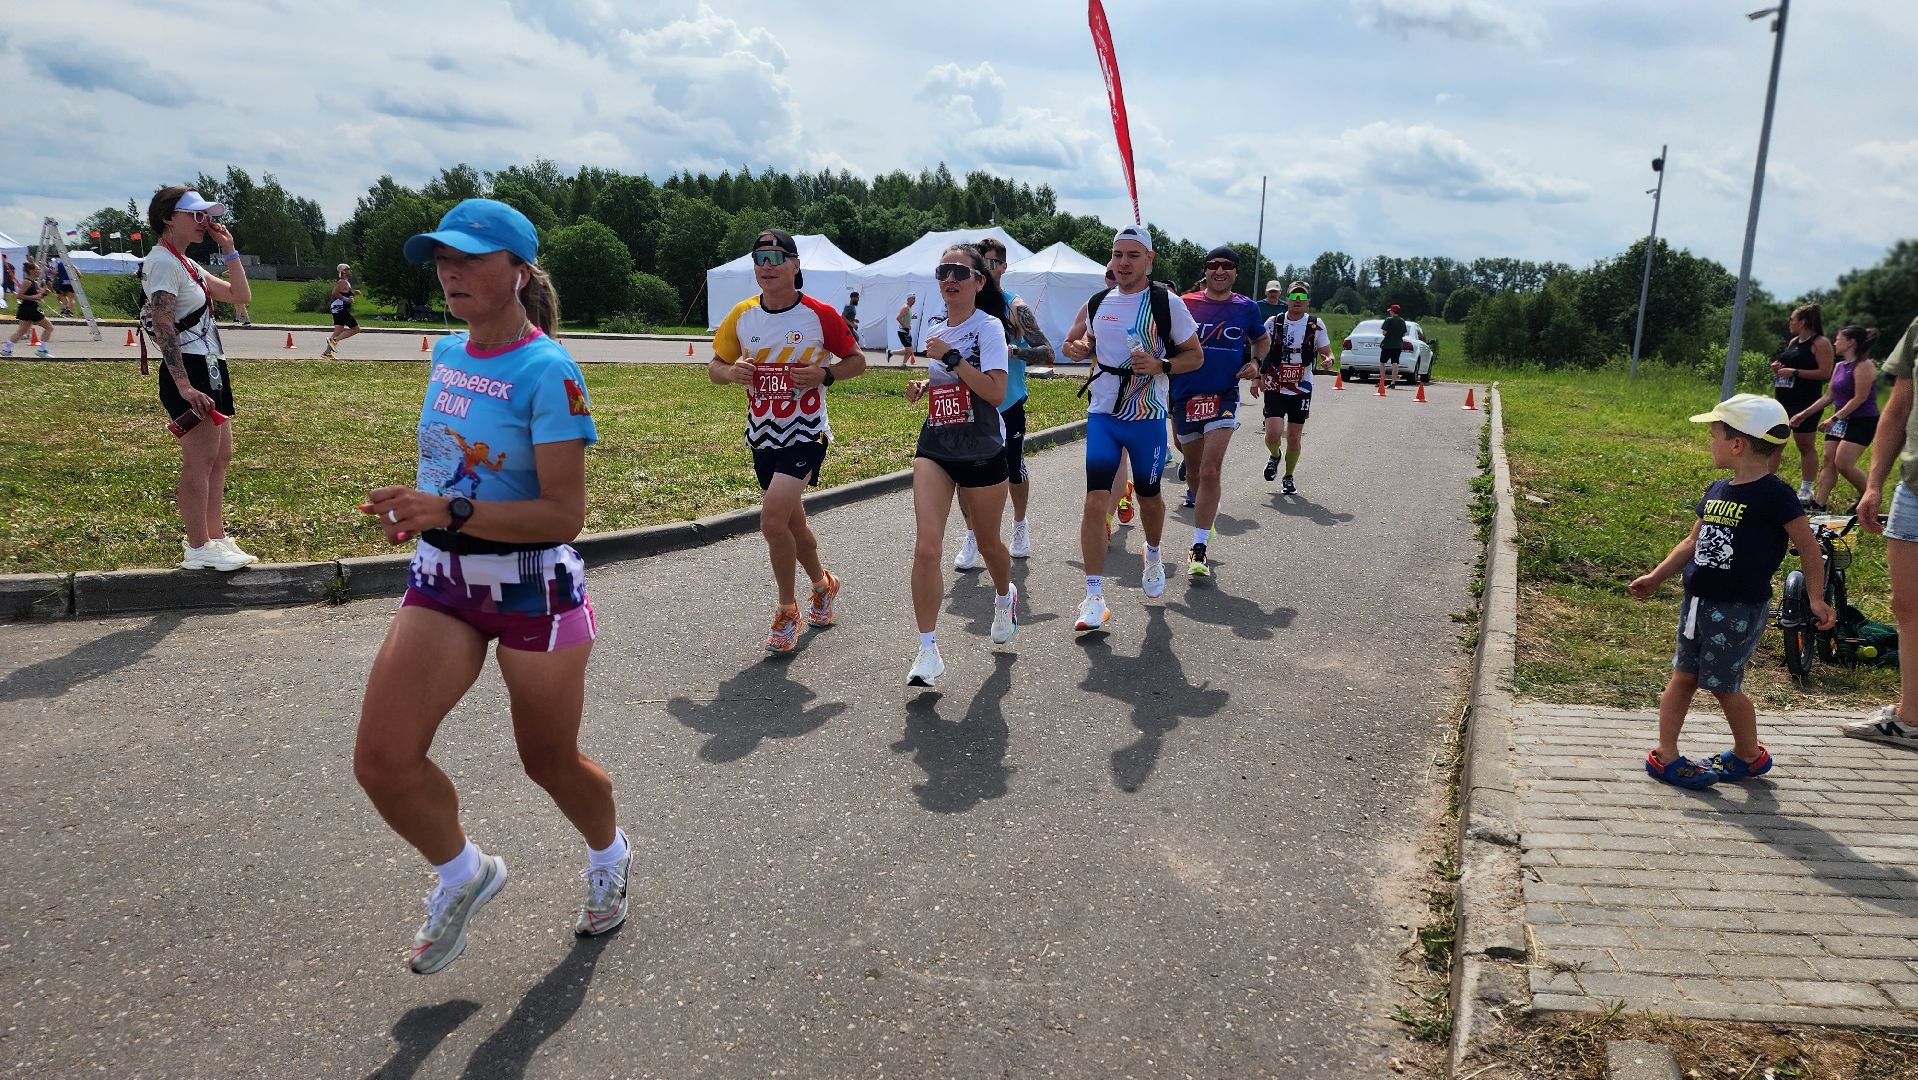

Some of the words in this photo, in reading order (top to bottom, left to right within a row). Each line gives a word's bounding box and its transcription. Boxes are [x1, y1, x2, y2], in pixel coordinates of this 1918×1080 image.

[431, 363, 513, 400] Егорьевск
[759, 375, 788, 392] 2184
[432, 391, 472, 418] RUN
[934, 397, 960, 417] 2185
[1193, 402, 1215, 416] 2113
[1703, 499, 1747, 519] FUTURE
